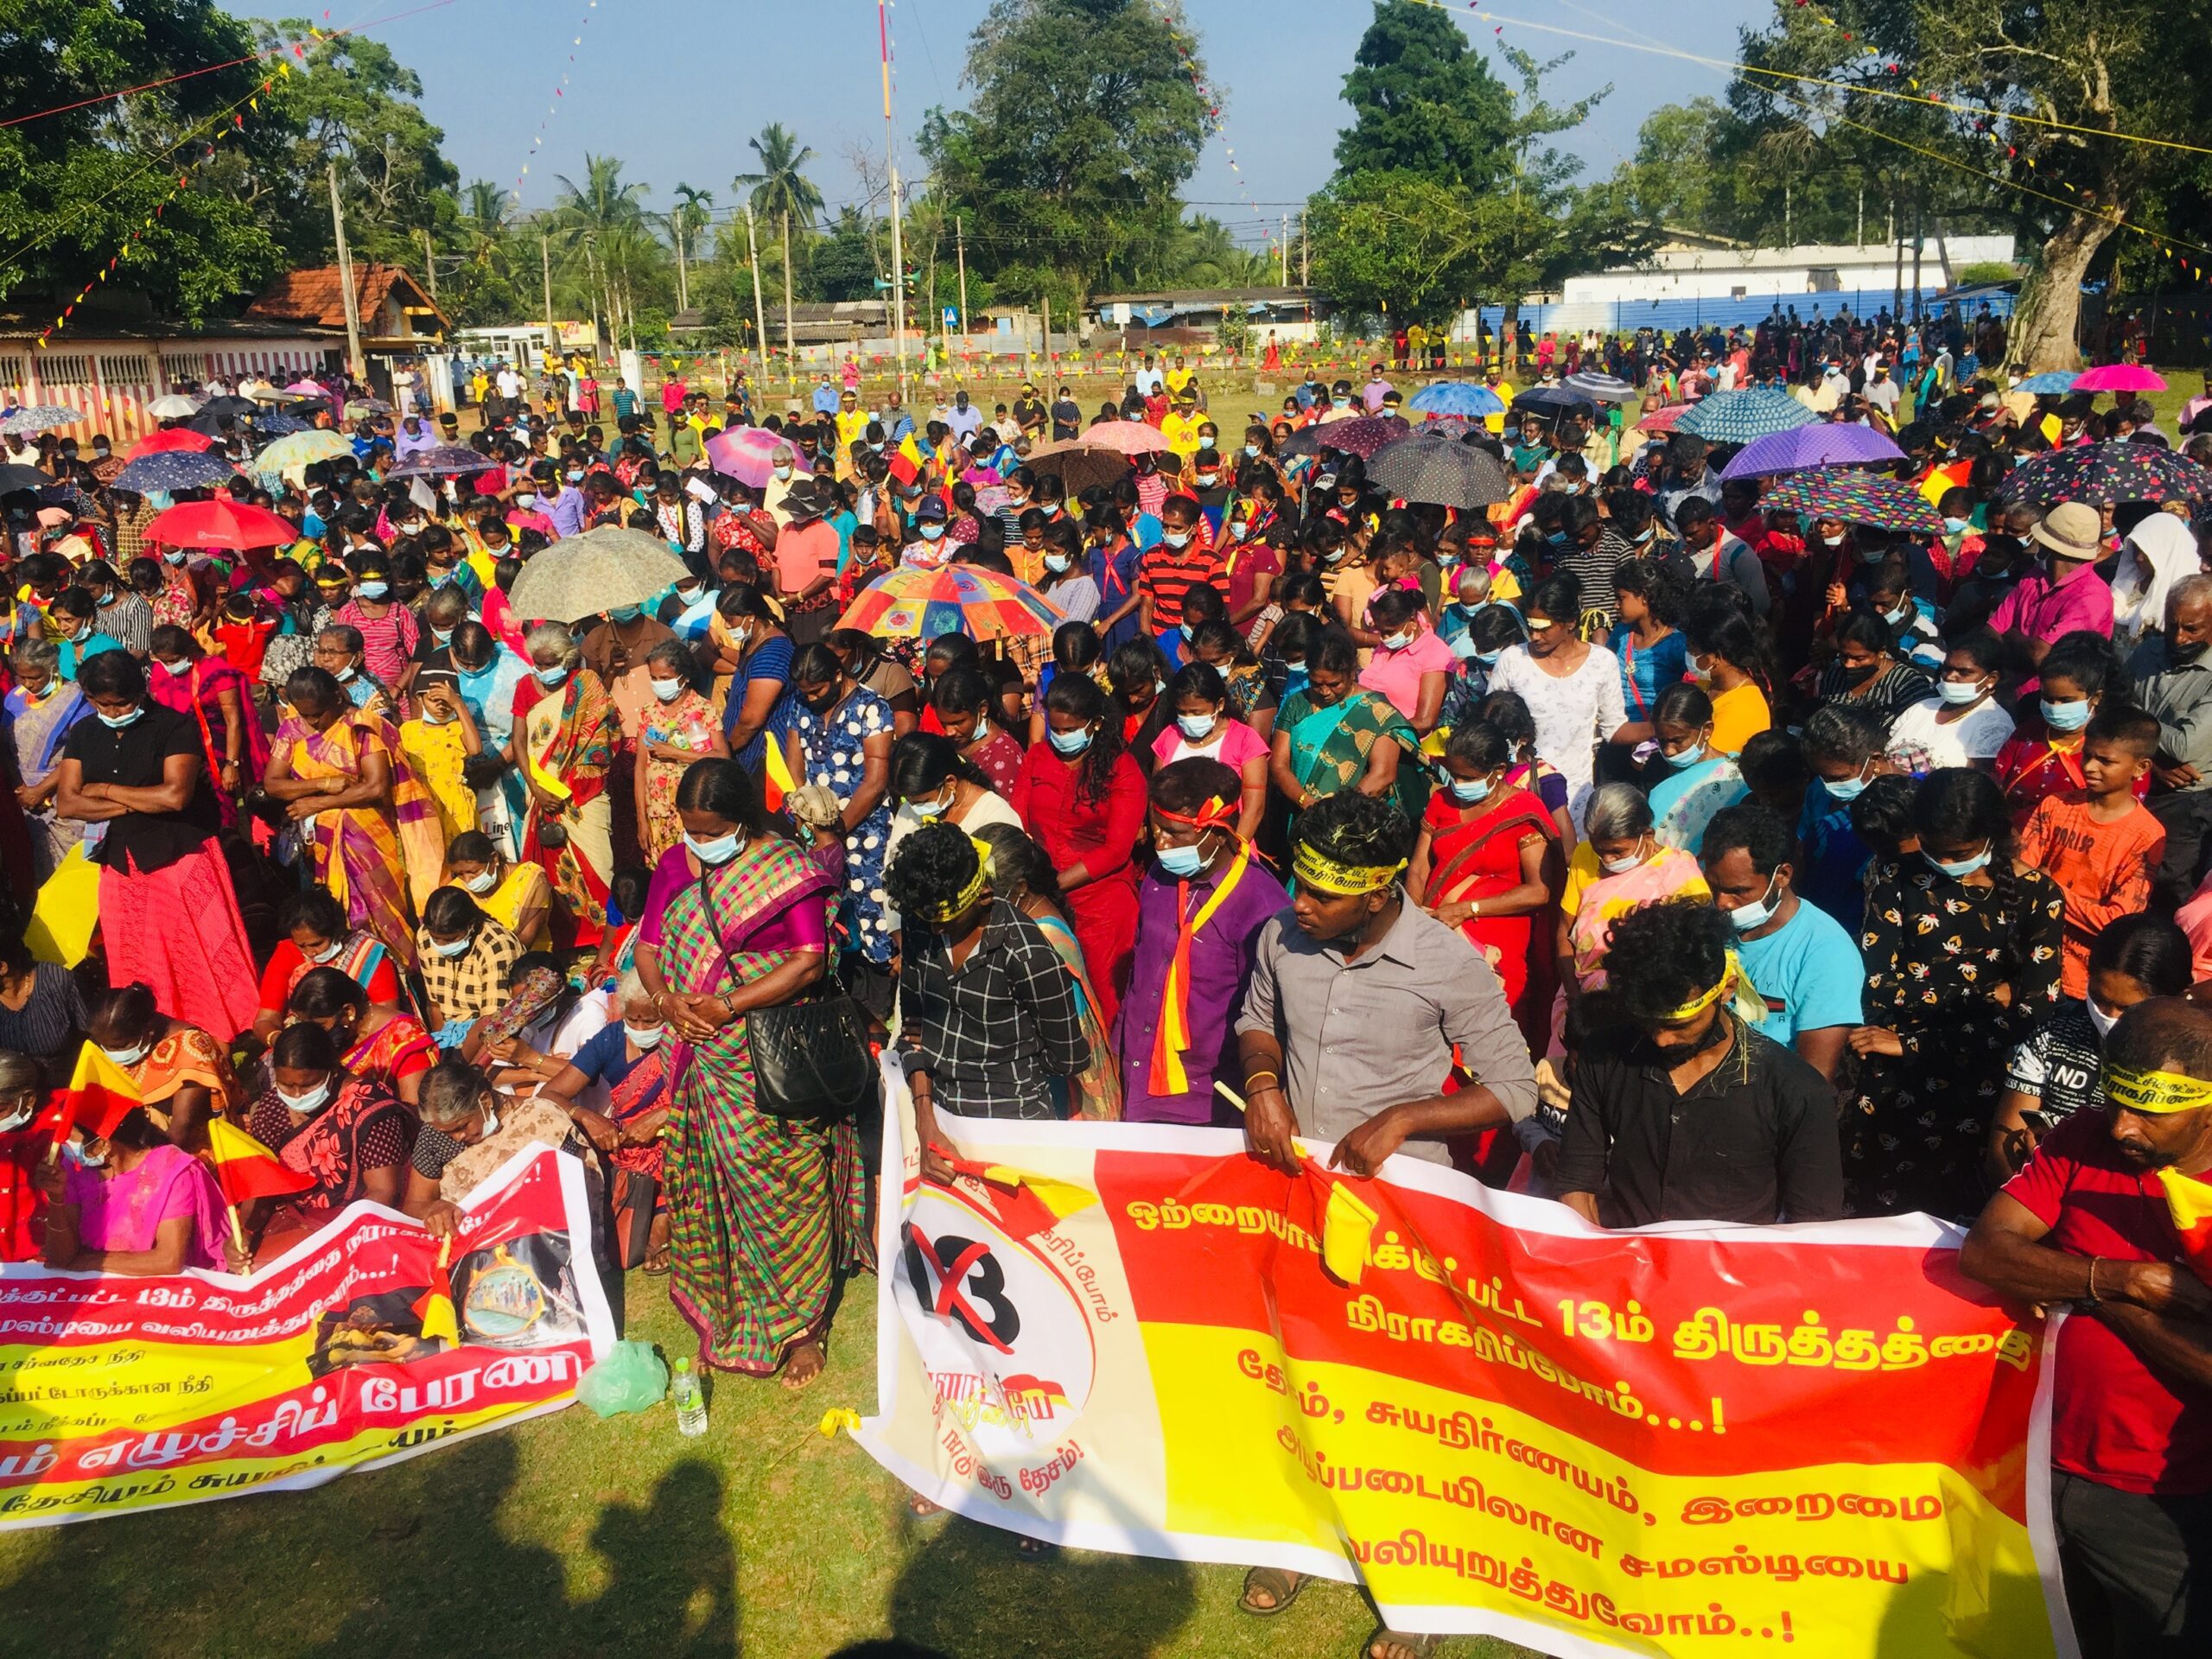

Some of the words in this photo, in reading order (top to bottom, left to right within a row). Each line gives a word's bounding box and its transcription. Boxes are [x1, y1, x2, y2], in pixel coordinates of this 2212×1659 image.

[0, 1287, 128, 1306] க்குட்பட்ட
[136, 1287, 196, 1308] 13ம்
[1557, 1299, 1655, 1343] 13ம்
[1674, 1306, 2034, 1372] திருத்தத்தை
[1237, 1348, 1345, 1425] தேம்,
[1680, 1492, 1943, 1527] இறைமை
